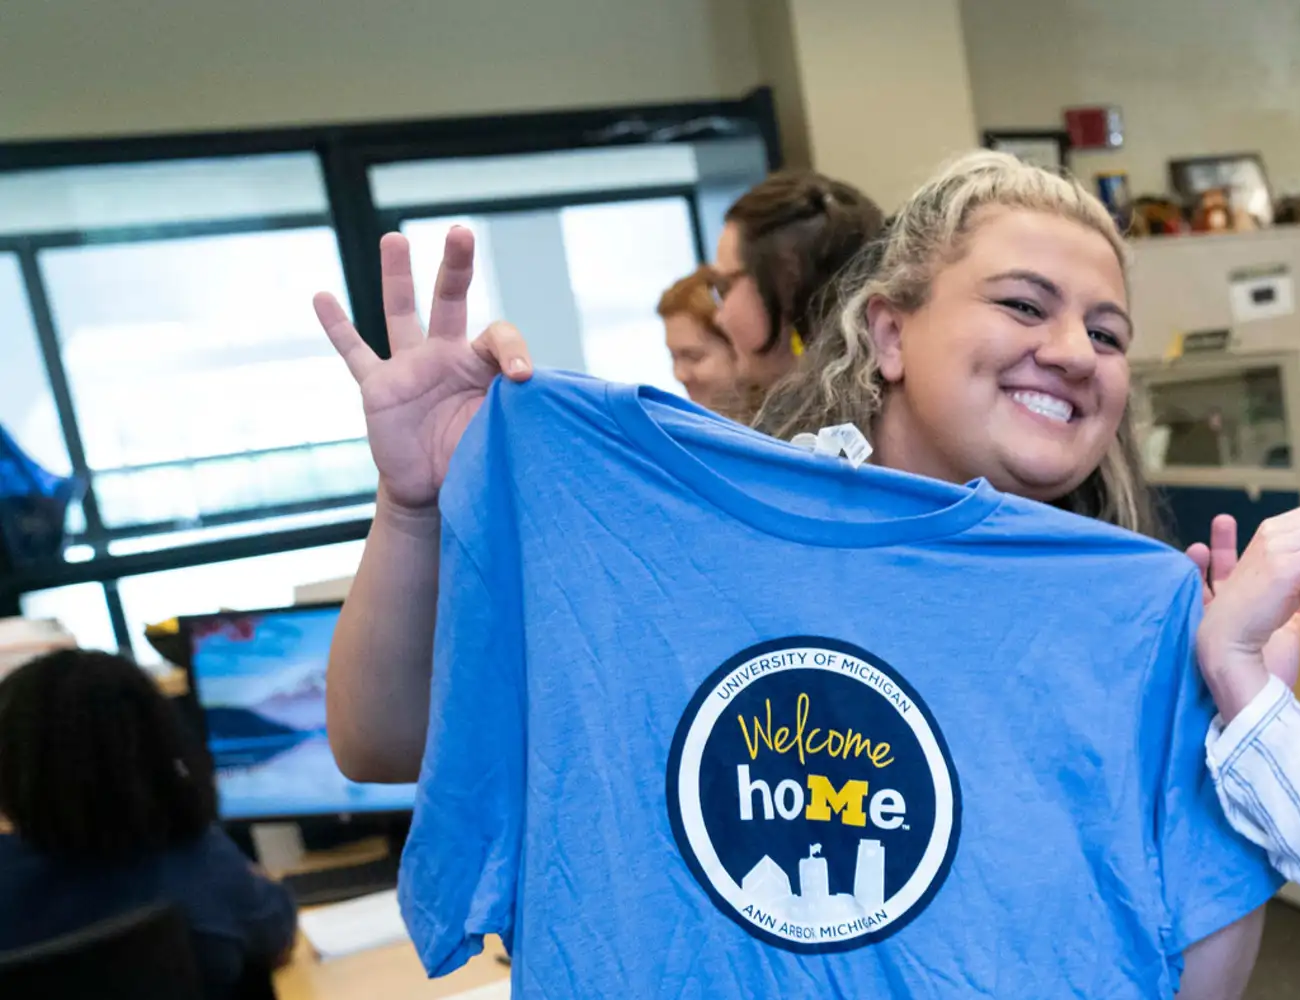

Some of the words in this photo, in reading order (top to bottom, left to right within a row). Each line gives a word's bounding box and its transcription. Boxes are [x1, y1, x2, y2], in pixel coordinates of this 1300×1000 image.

[717, 652, 807, 701] UNIVERSITY
[813, 652, 836, 666] OF
[841, 658, 911, 714] MICHIGAN
[737, 692, 895, 769] Welcome
[736, 763, 907, 831] hoMe
[742, 904, 777, 929] ANN
